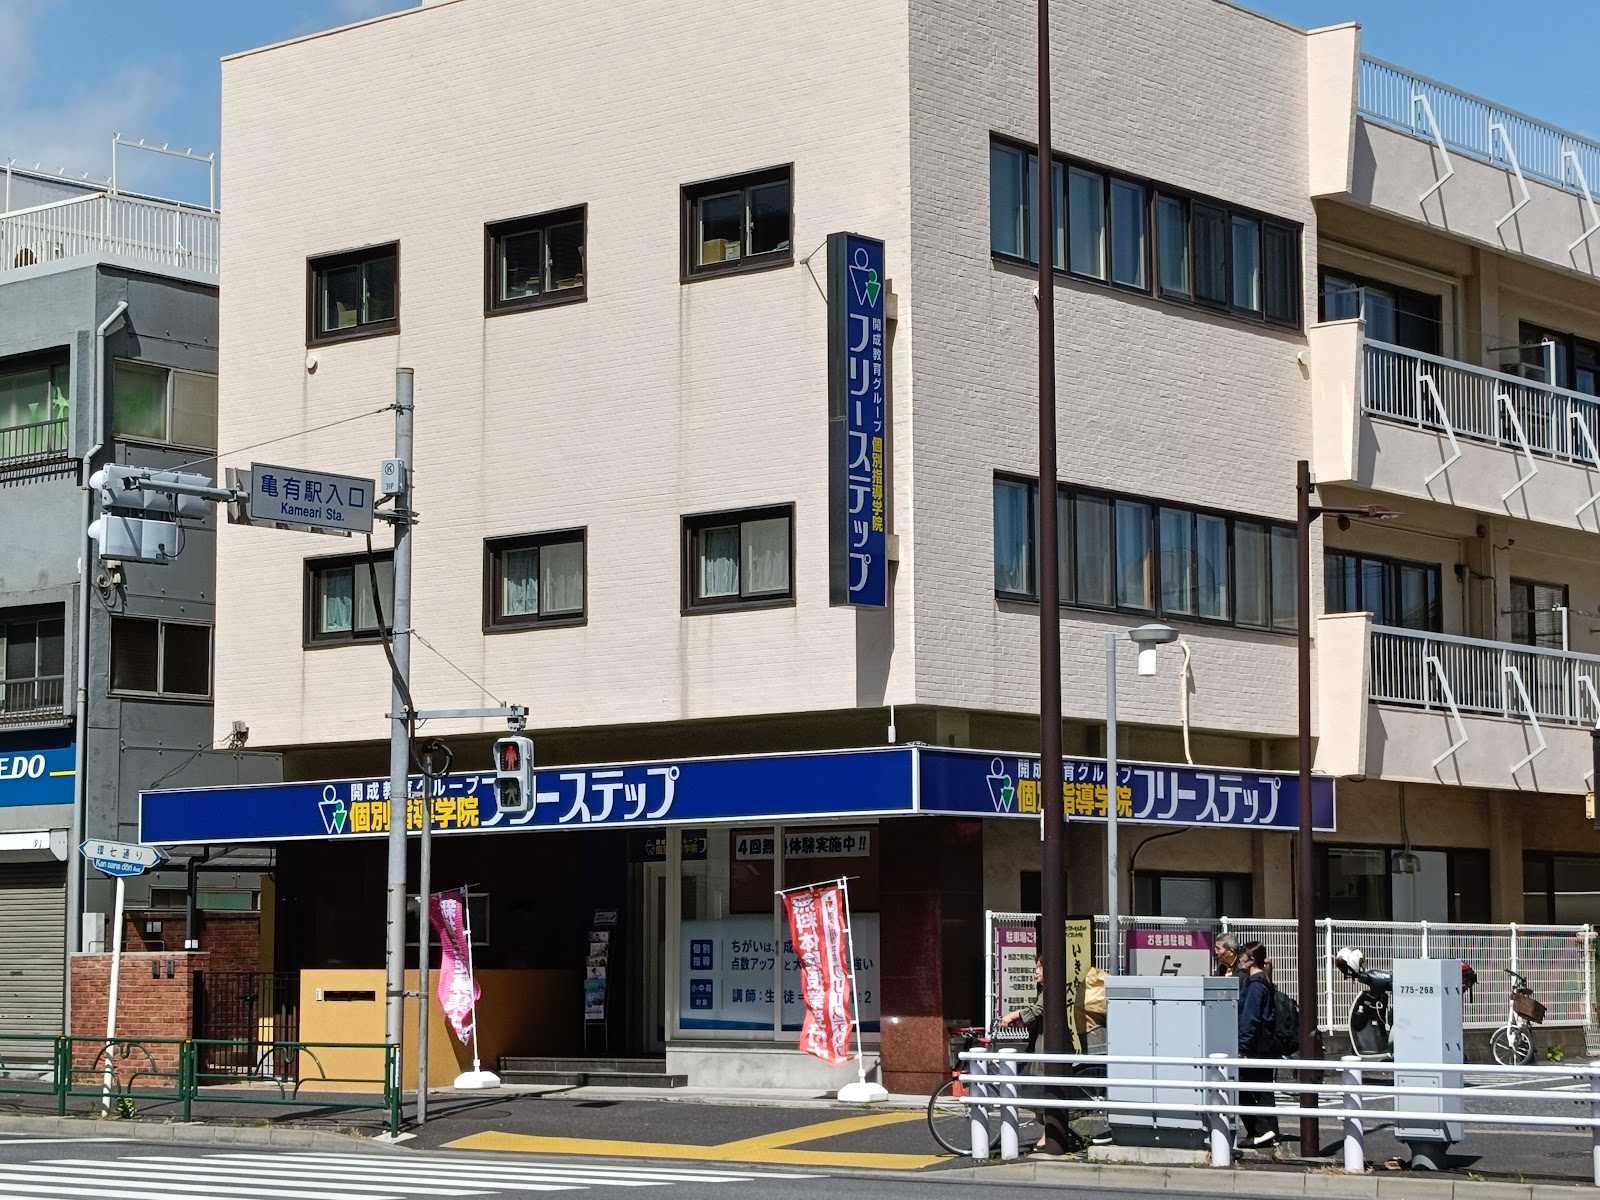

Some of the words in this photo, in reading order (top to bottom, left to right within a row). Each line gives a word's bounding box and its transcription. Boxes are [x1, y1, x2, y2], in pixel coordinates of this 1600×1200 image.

[872, 317, 882, 433] 開成教育グループ
[848, 312, 872, 592] フリーステップ
[260, 474, 365, 508] 亀有駅入口
[871, 436, 884, 532] 個別指導学院
[281, 502, 322, 519] Kameari
[325, 507, 345, 522] Sta.
[1133, 769, 1282, 824] フリーステップ
[96, 845, 143, 861] 環七通り
[738, 836, 867, 856] 4回無体験実施中!!
[1147, 934, 1193, 947] お客様駐輪場
[1400, 986, 1434, 994] 775-268
